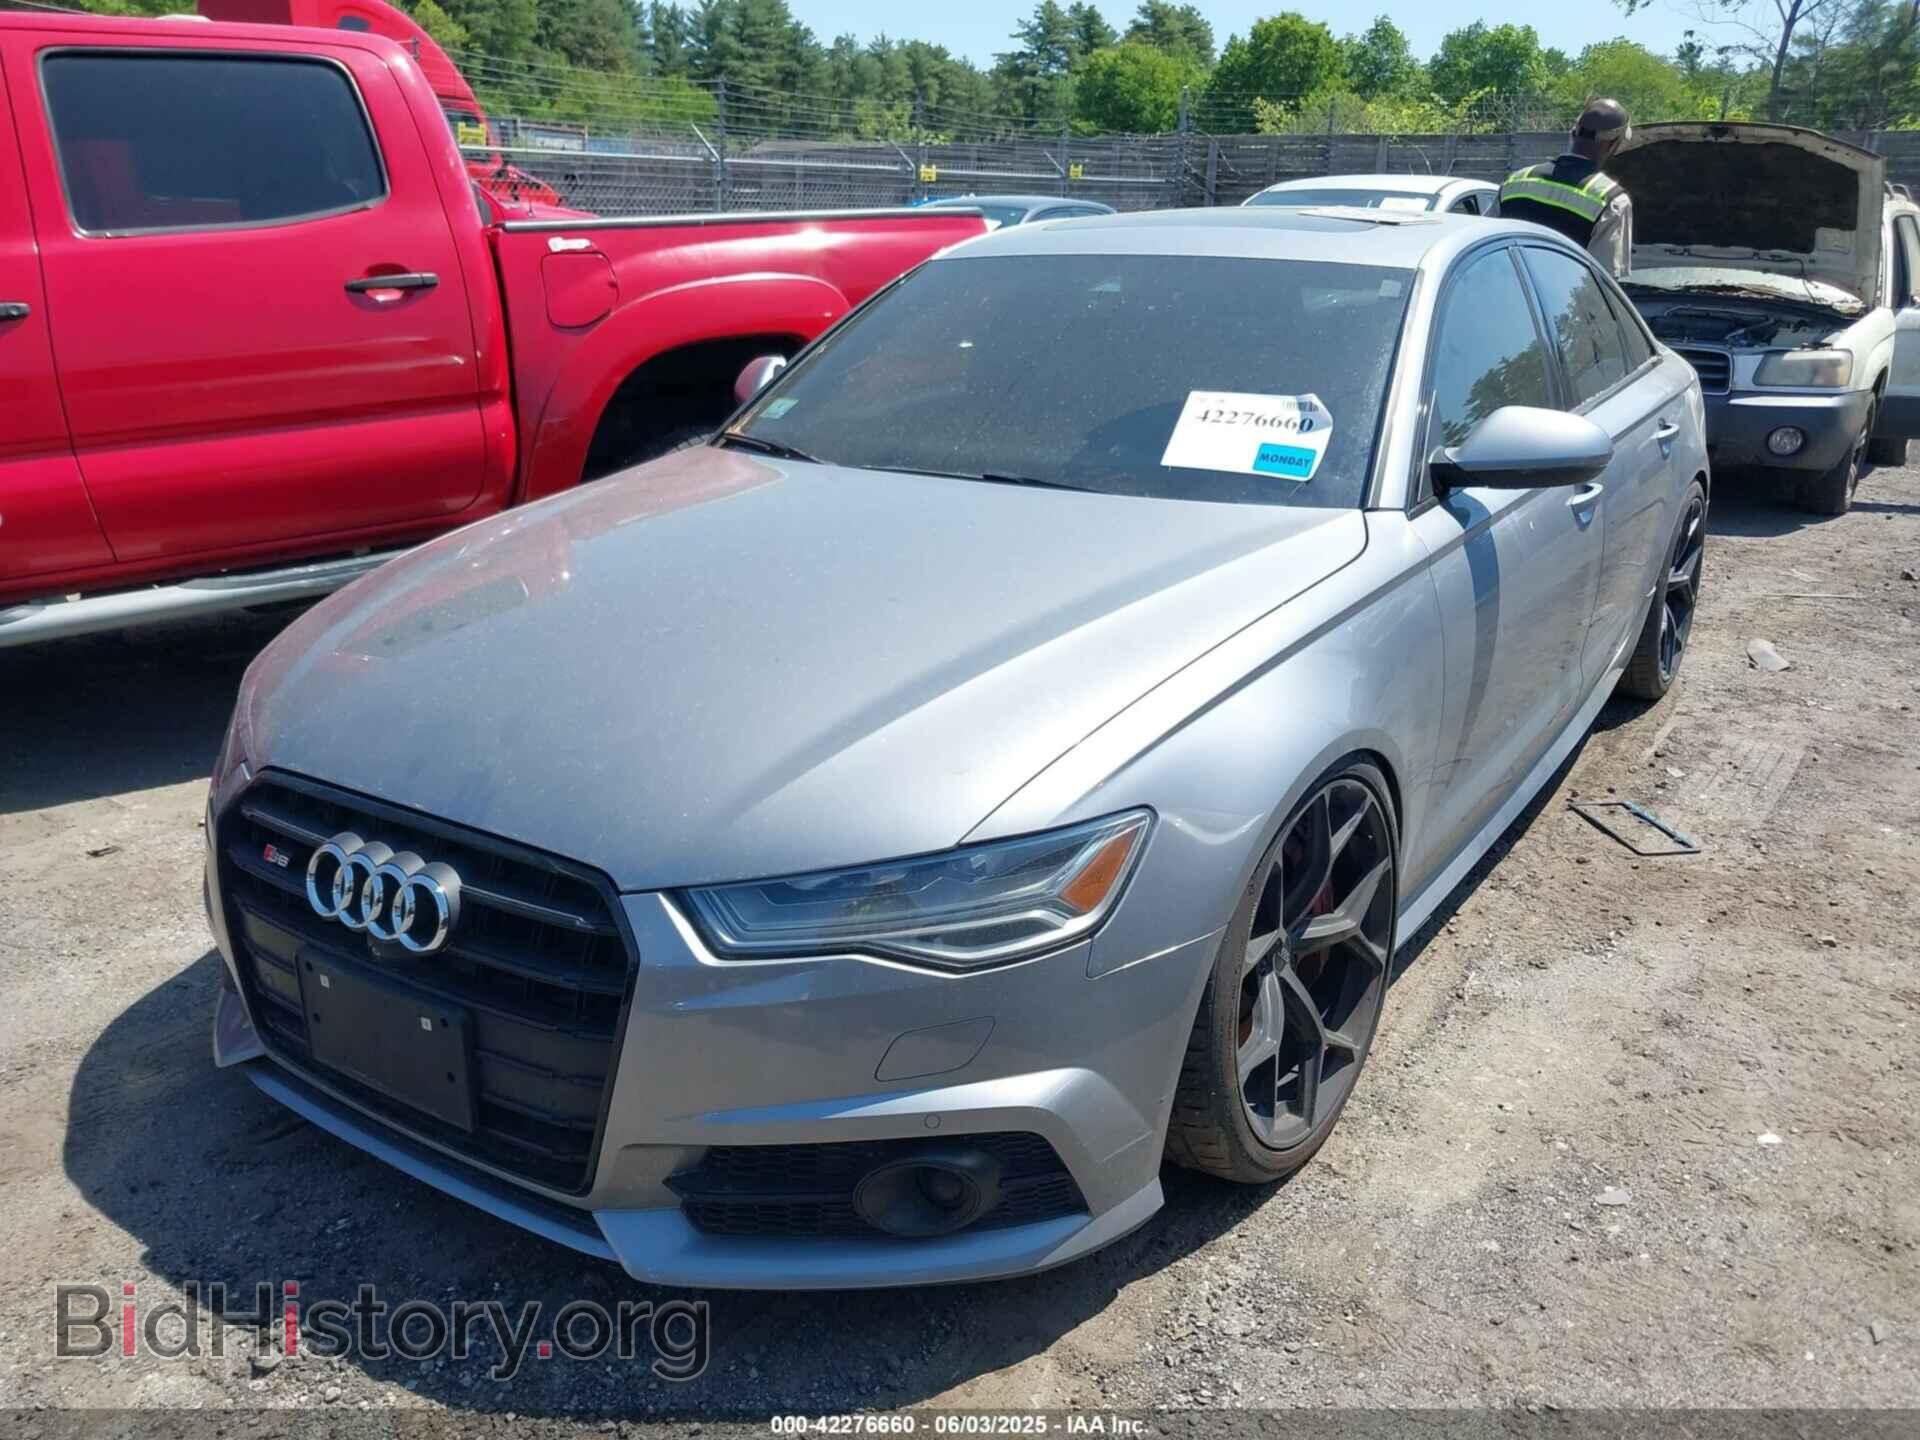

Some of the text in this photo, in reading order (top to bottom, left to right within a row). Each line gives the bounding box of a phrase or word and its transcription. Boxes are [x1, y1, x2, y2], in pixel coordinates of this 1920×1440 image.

[1196, 408, 1314, 432] 42276660
[1259, 452, 1312, 469] MONDAY
[263, 843, 289, 867] S6
